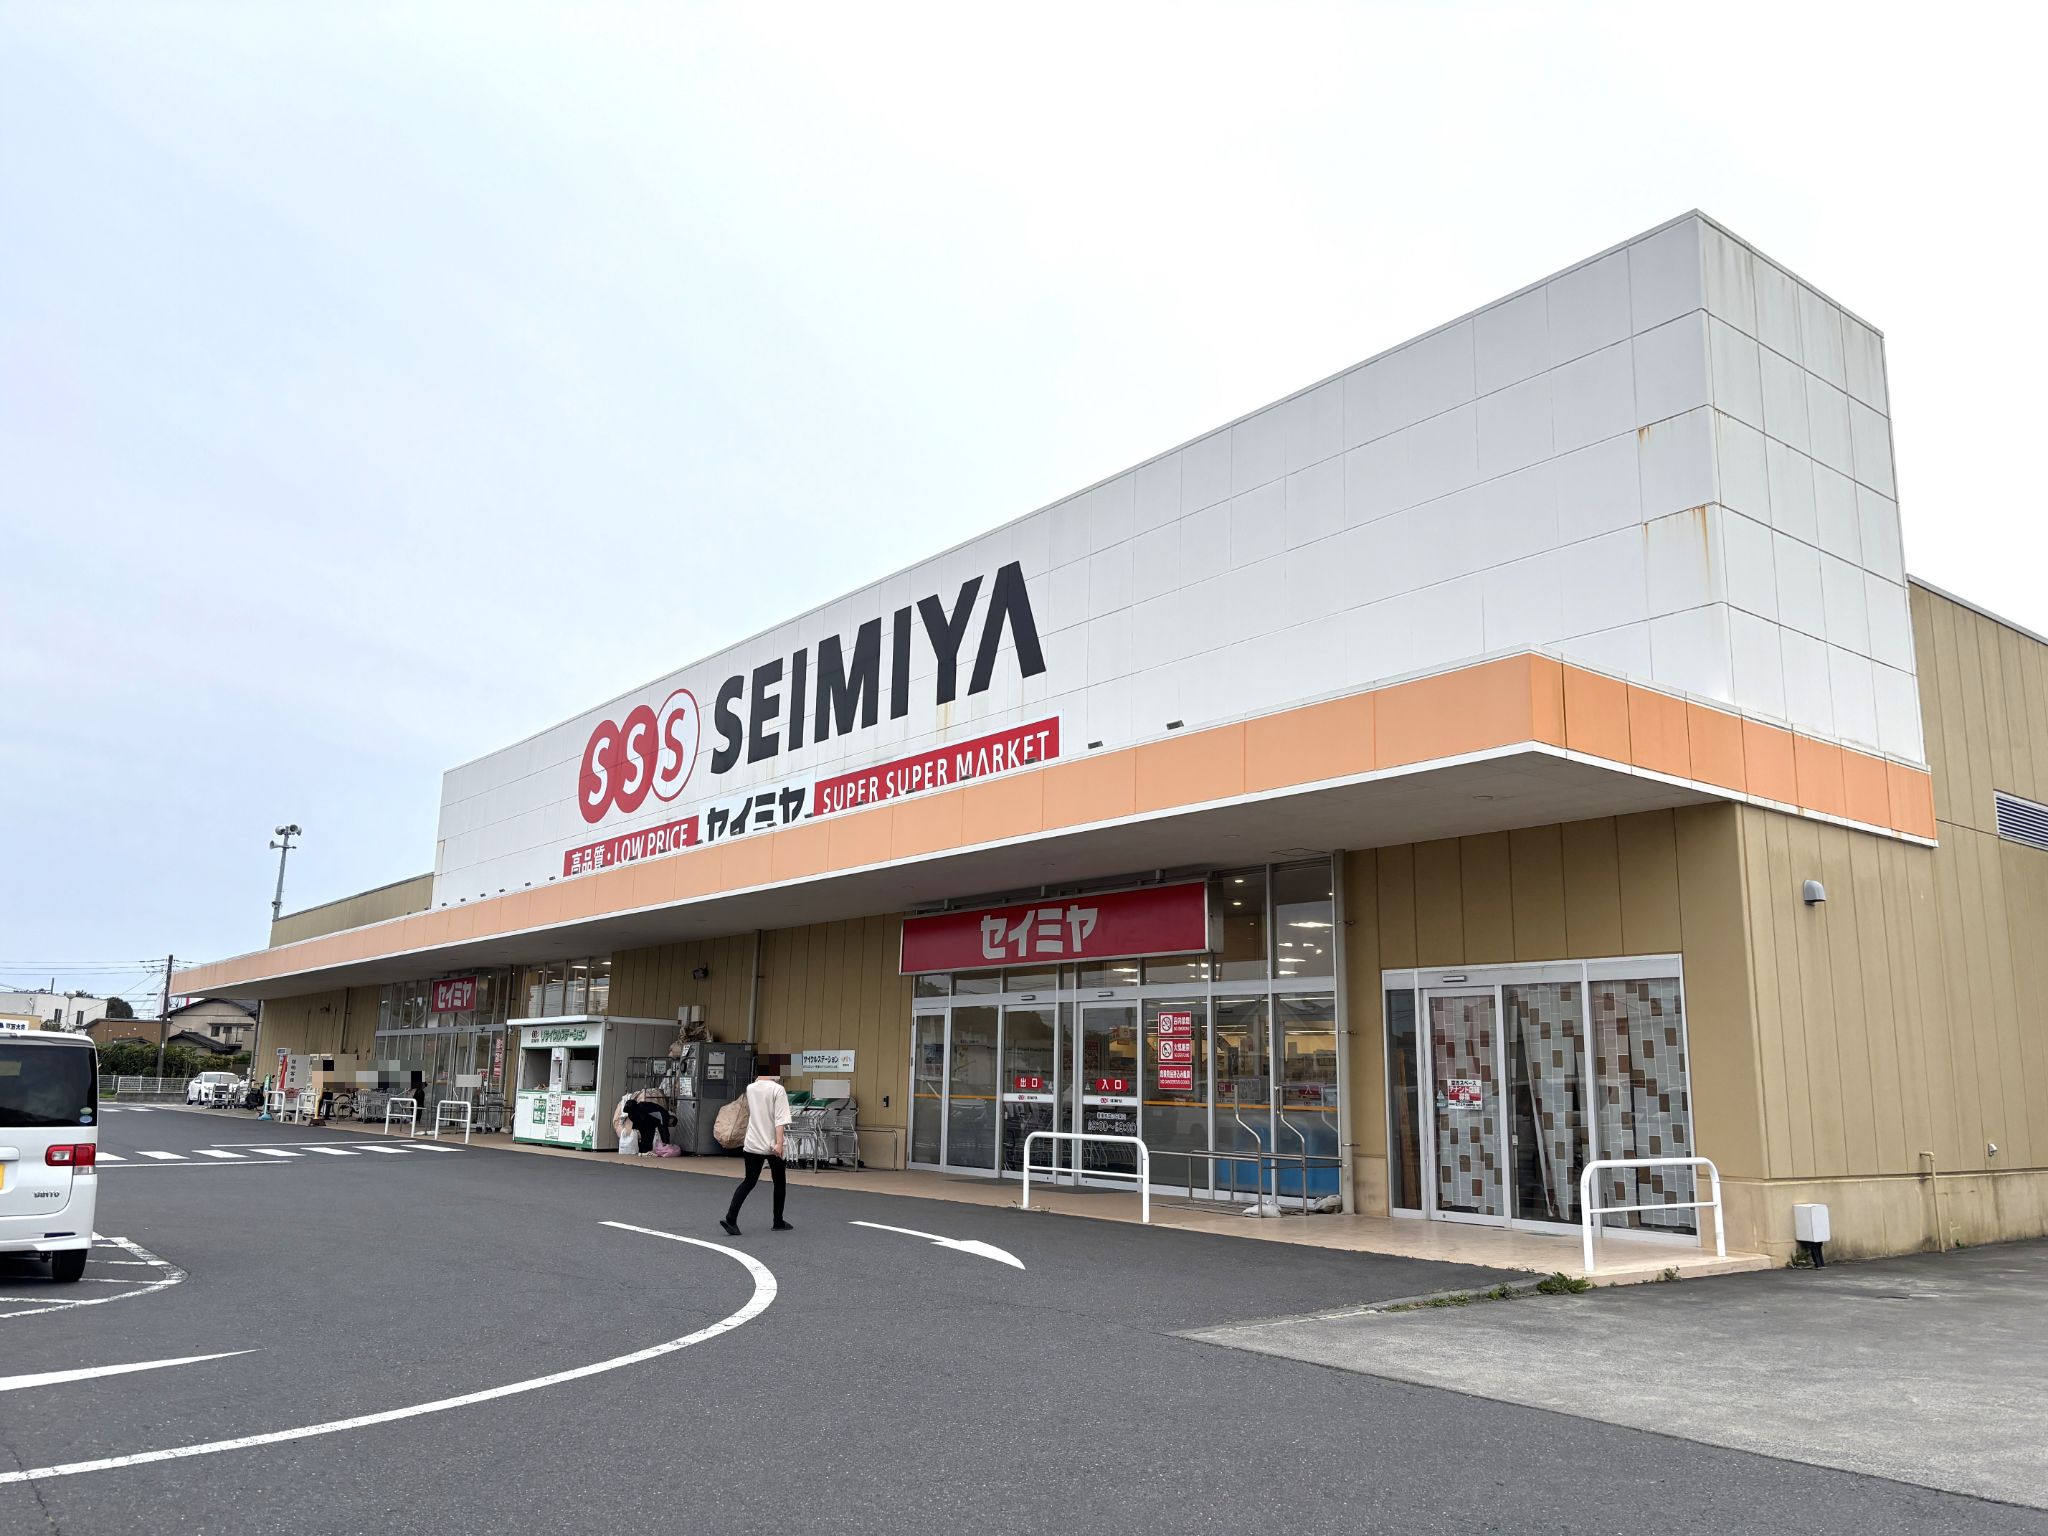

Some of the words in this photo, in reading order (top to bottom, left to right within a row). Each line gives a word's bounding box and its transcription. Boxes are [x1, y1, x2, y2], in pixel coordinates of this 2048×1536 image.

[710, 560, 1047, 775] SEIMIYA
[822, 776, 878, 814] SUPER
[886, 758, 948, 800] SUPER
[956, 730, 1050, 781] MARKET
[647, 824, 689, 858] PRICE
[980, 904, 1098, 960] セイミヤ
[437, 982, 473, 1009] セイミヤ
[1020, 1077, 1038, 1088] 出口
[1101, 1079, 1122, 1090] 入口
